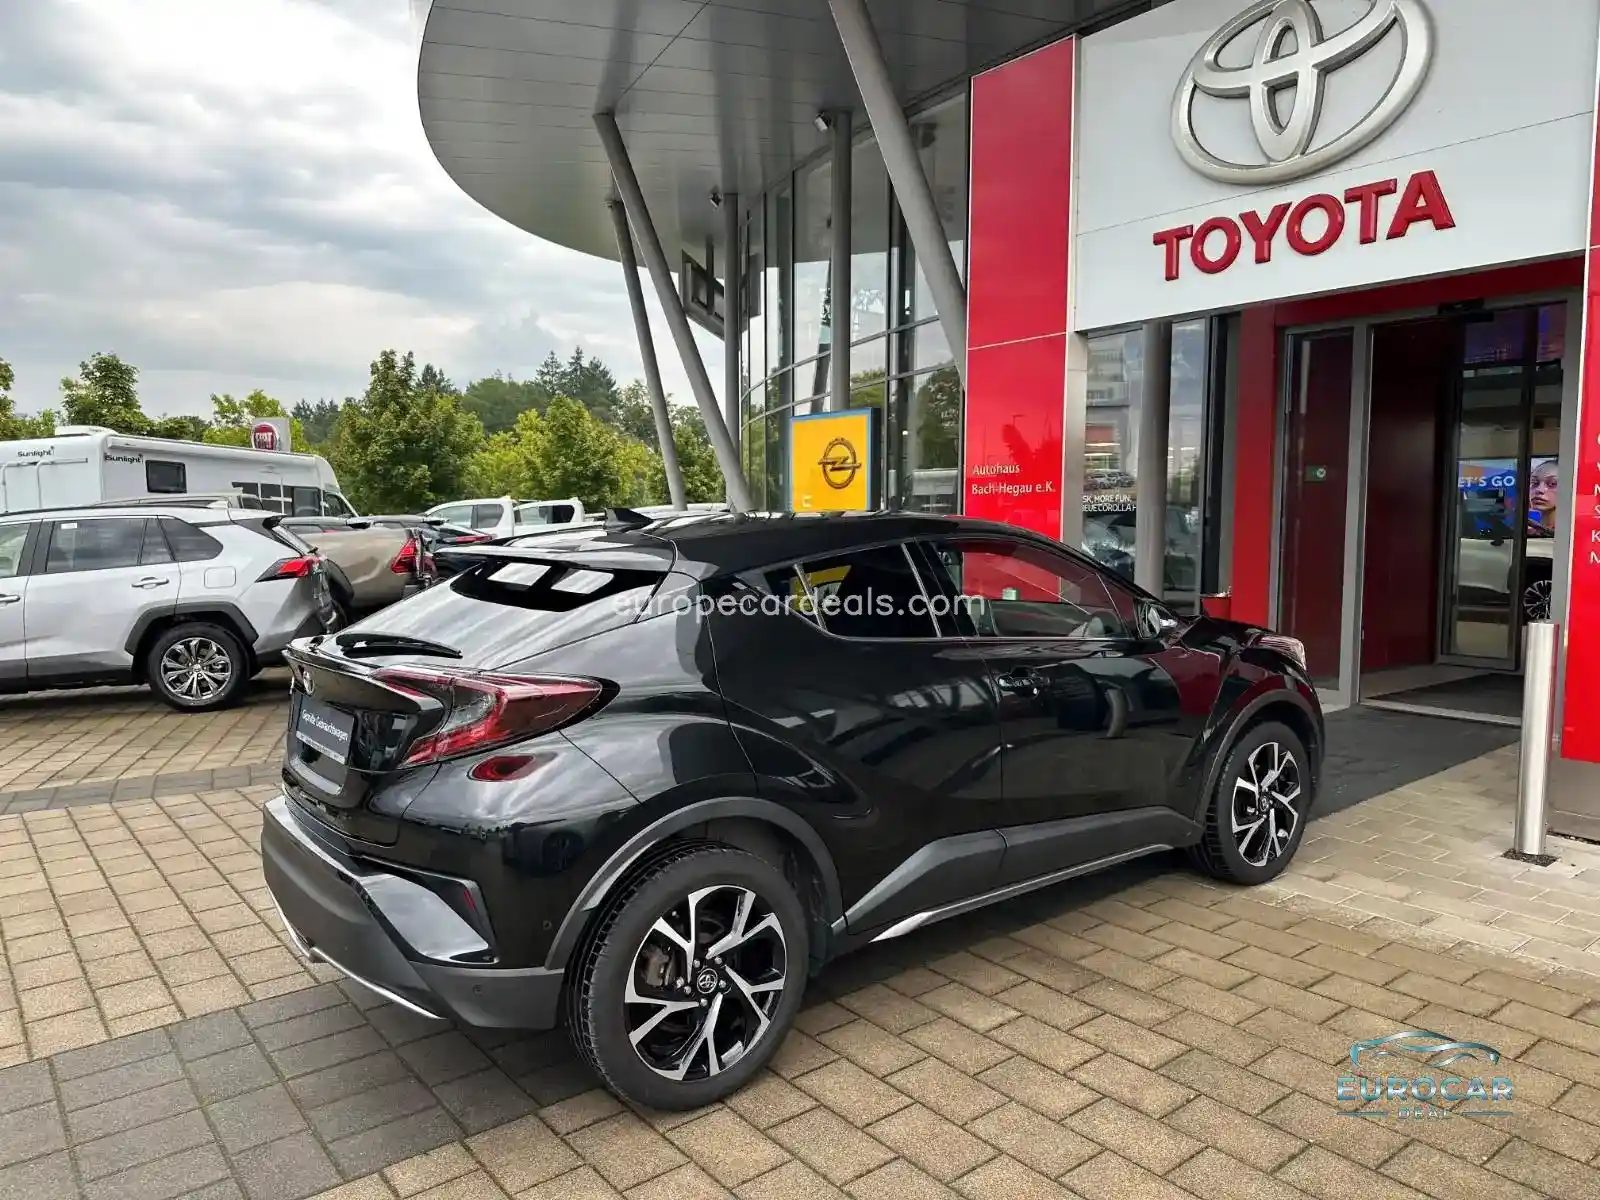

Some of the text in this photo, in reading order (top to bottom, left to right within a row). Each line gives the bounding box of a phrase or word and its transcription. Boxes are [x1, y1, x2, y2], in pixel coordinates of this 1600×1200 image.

[1153, 170, 1456, 281] TOYOTA
[17, 449, 52, 457] Sunlight
[106, 454, 141, 464] Sunlight
[973, 463, 1020, 475] Autohaus
[1458, 475, 1515, 487] ET'S GO
[971, 481, 1056, 496] Bach-Hegau e.K.
[1098, 504, 1132, 512] COROLLA
